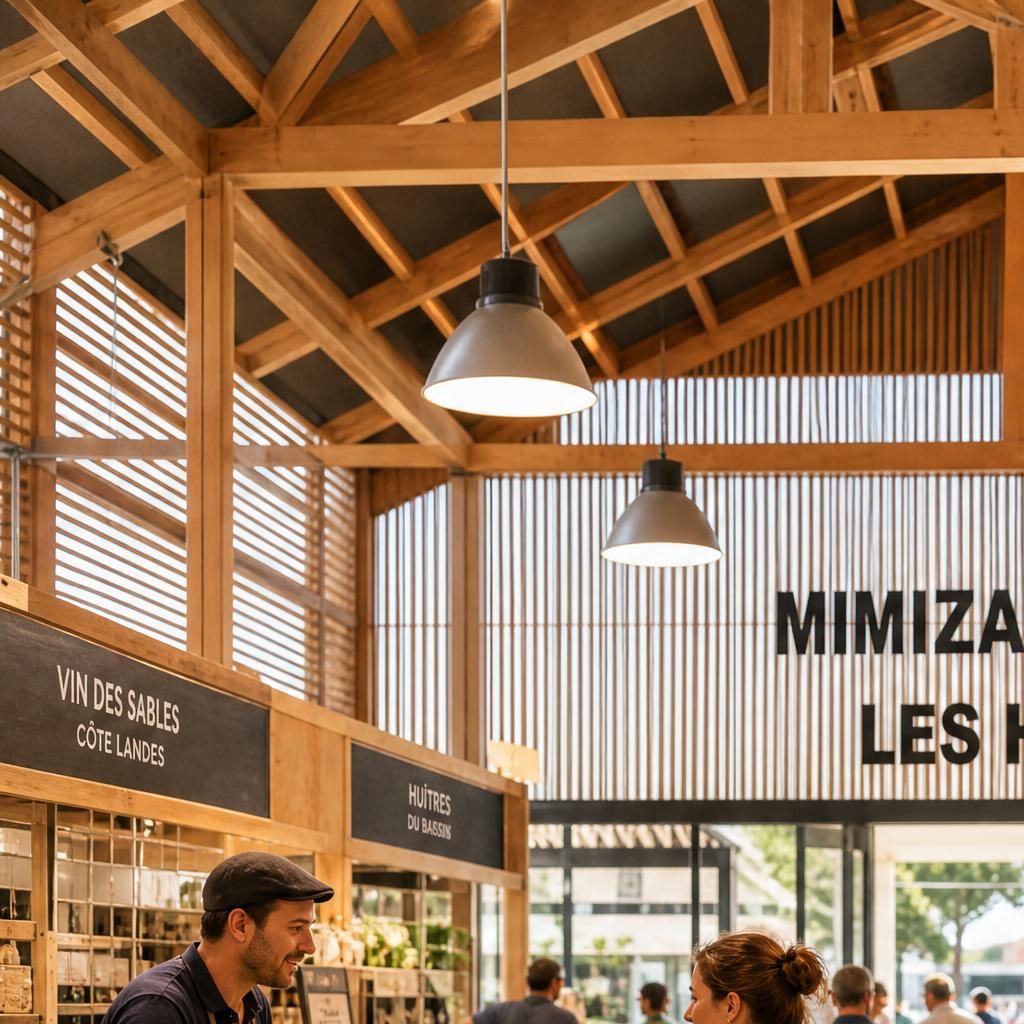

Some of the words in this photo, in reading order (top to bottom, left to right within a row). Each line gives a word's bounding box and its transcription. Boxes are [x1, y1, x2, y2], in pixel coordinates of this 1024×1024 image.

[56, 664, 88, 708] VIN
[93, 677, 123, 717] DES
[127, 689, 180, 734] SABLES
[76, 720, 113, 755] CÔTE
[116, 733, 165, 767] LANDES
[861, 702, 981, 766] LES
[407, 813, 420, 831] DU
